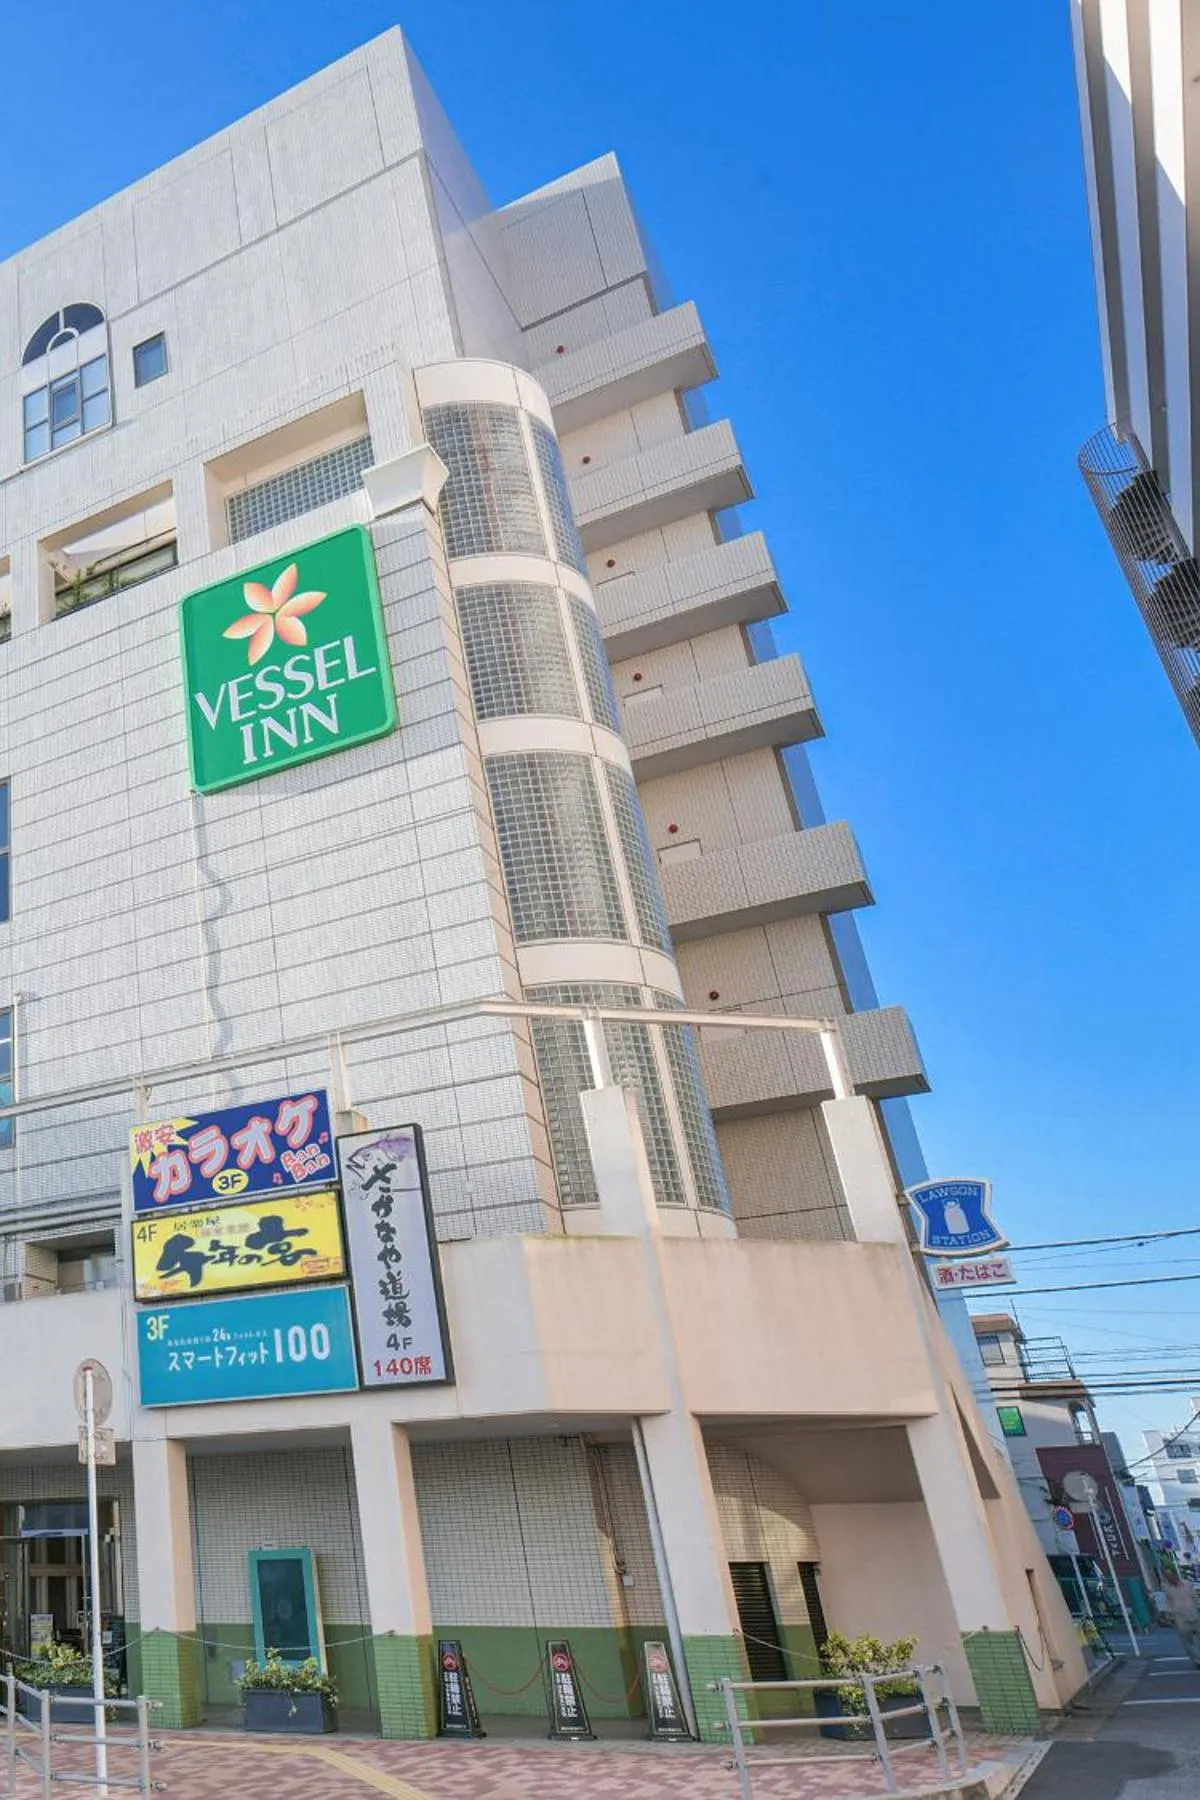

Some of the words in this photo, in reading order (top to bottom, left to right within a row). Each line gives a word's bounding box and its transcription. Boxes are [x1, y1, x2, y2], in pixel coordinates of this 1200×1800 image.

[195, 635, 377, 730] VESSEL
[240, 693, 340, 765] INN
[135, 1123, 177, 1152] 激安
[148, 1094, 320, 1204] カラオケ
[217, 1174, 244, 1190] 3F
[918, 1186, 979, 1203] LAWSON
[136, 1223, 158, 1243] 4F
[931, 1229, 991, 1246] STATION
[156, 1214, 318, 1288] 千年の宴
[146, 1314, 170, 1341] 3F
[168, 1342, 269, 1372] スマートフィット
[274, 1323, 331, 1364] 100
[386, 1333, 414, 1352] 4F
[373, 1355, 433, 1377] 140席
